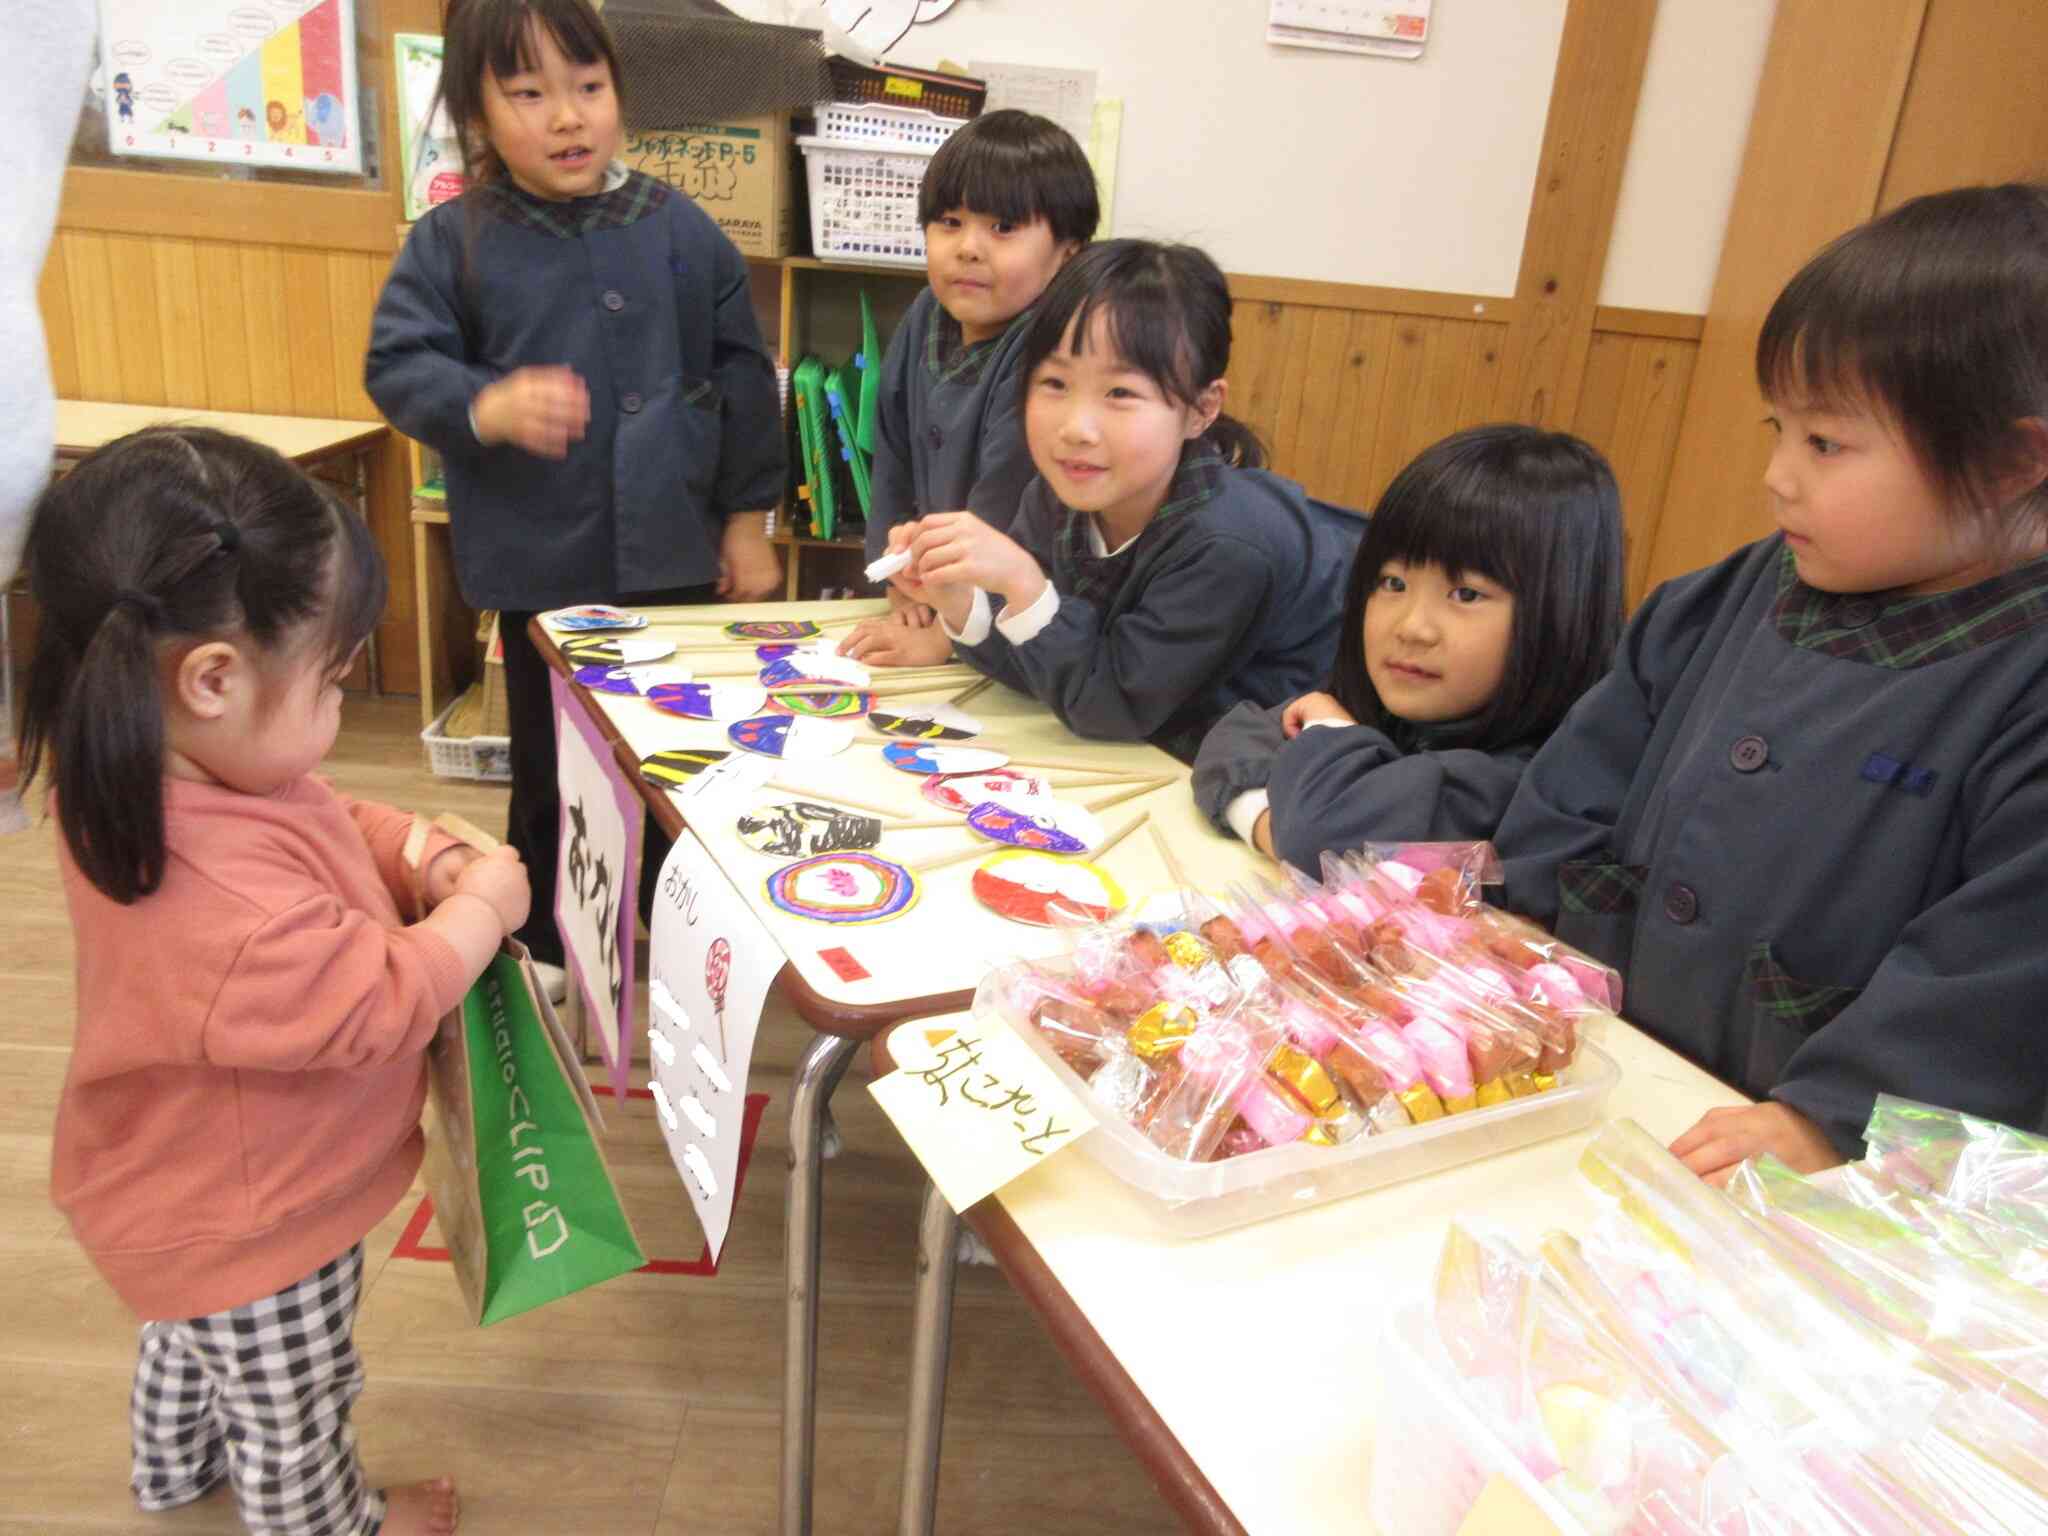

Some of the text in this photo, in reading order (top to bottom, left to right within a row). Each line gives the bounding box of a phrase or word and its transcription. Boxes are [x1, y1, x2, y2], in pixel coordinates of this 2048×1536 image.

[718, 217, 762, 230] SARAYA
[664, 864, 699, 927] おかし
[505, 1086, 551, 1191] CLIP
